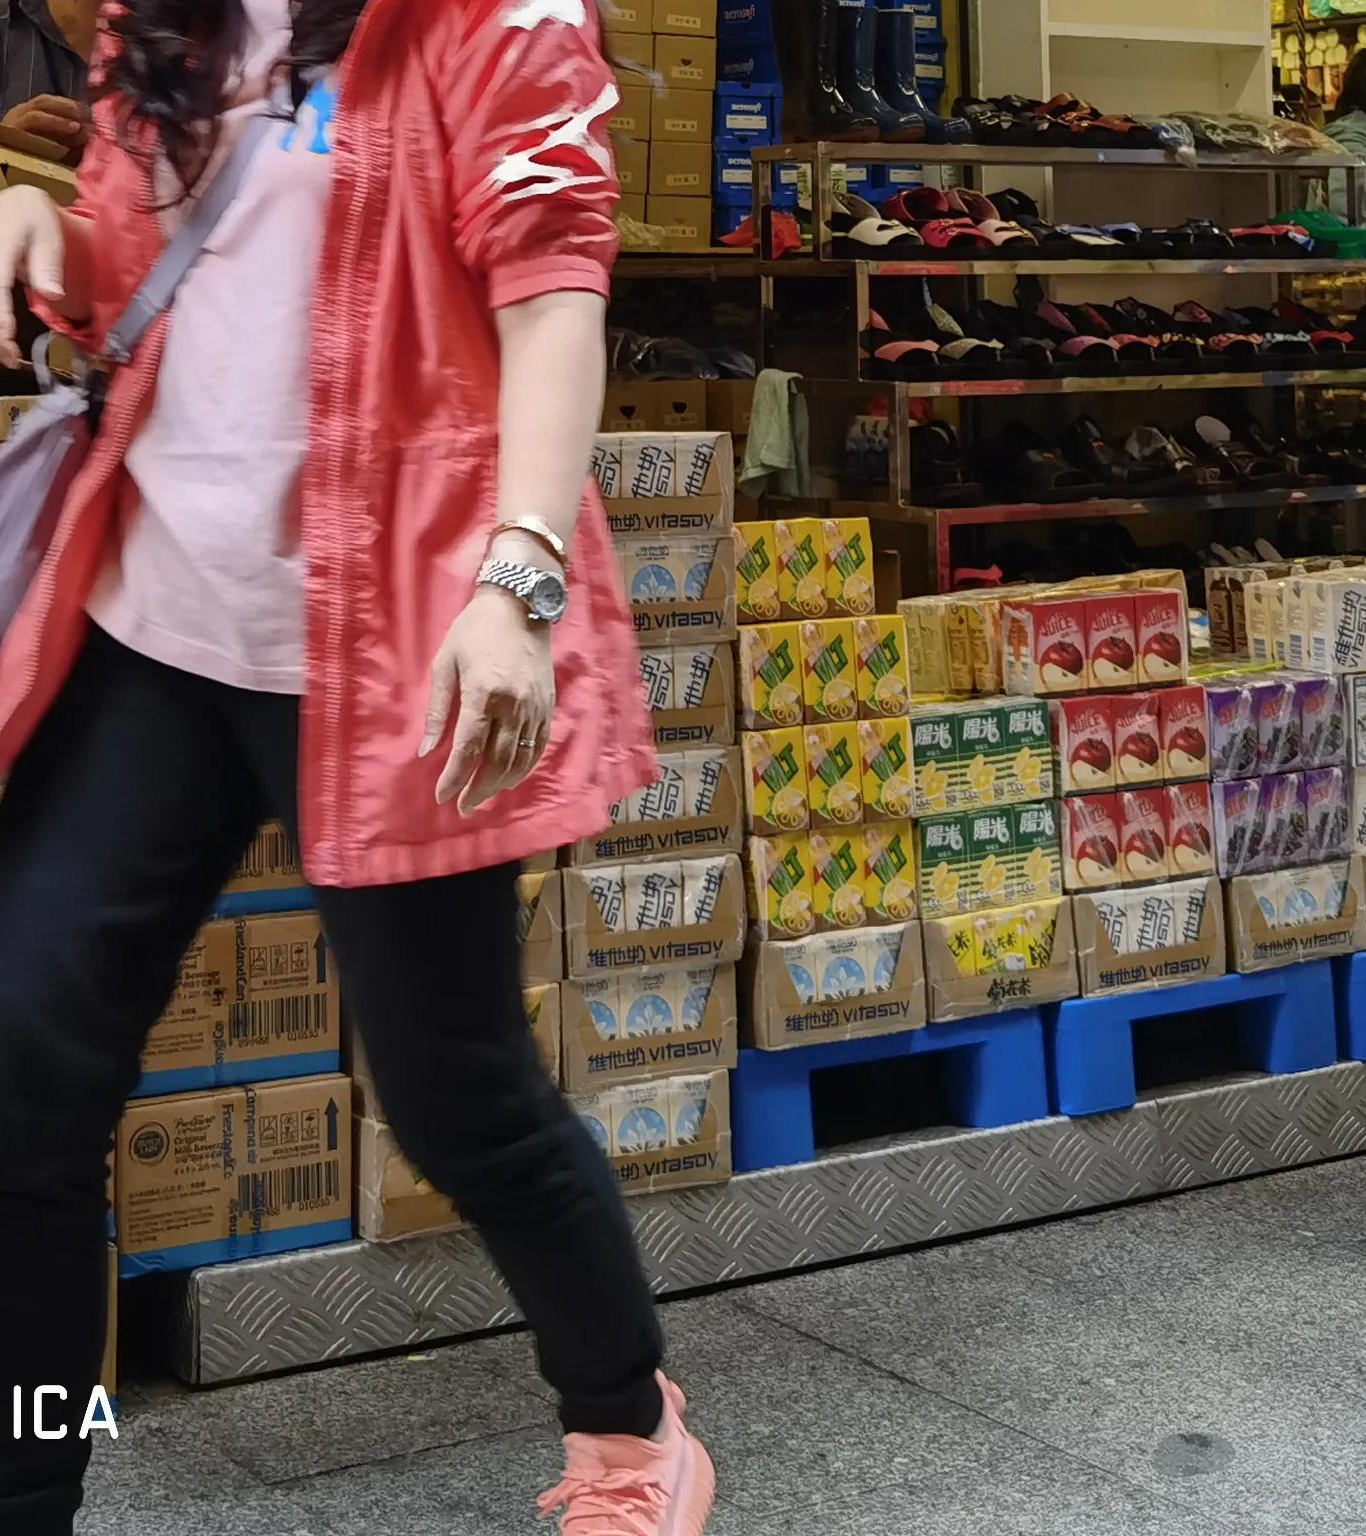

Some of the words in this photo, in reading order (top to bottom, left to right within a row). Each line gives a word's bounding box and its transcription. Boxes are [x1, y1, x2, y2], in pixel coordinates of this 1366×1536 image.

[645, 513, 715, 531] vitasoy
[654, 610, 724, 629] vitasoy
[1041, 616, 1074, 637] JUICE
[1093, 612, 1124, 632] JUICE
[1142, 609, 1174, 628] JUICE
[963, 716, 1001, 744] 陽光
[1009, 710, 1045, 737] 陽光
[914, 722, 953, 750] 陽光
[973, 816, 1011, 844] 陽光
[1019, 809, 1055, 836] 陽光
[658, 825, 730, 848] vitasoy
[926, 823, 964, 851] 陽光
[649, 939, 724, 960] vitasoy
[1150, 956, 1211, 978] vitasoy
[843, 999, 911, 1024] vitasoy
[649, 1038, 723, 1061] vitasoy
[643, 1152, 719, 1177] vitasoy
